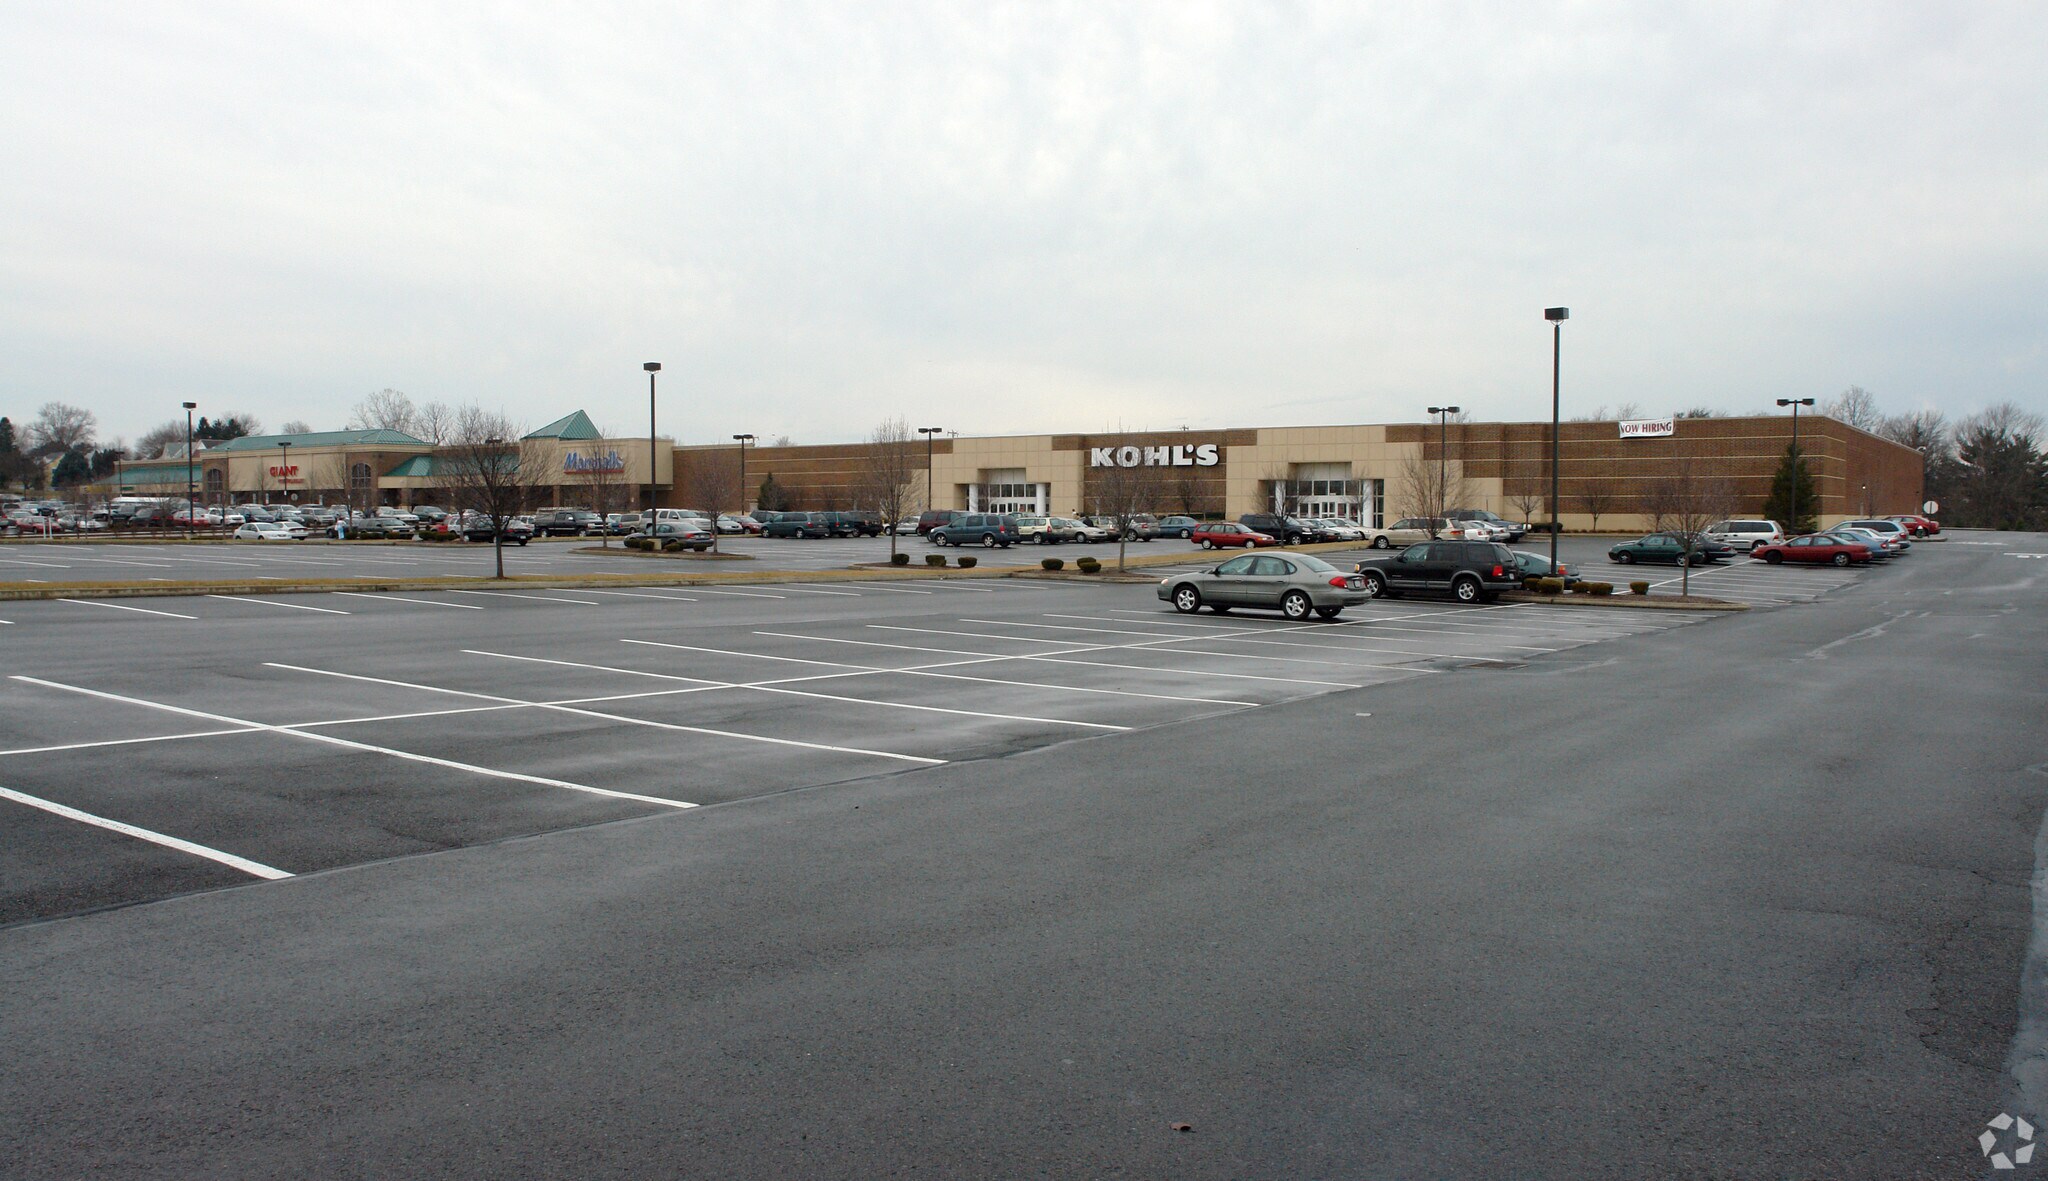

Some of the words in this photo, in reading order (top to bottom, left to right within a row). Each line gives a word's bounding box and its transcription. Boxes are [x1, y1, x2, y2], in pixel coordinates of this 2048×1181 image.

[1641, 422, 1672, 433] HIRING
[1091, 444, 1219, 468] KOHL'S
[269, 466, 299, 477] GIANT
